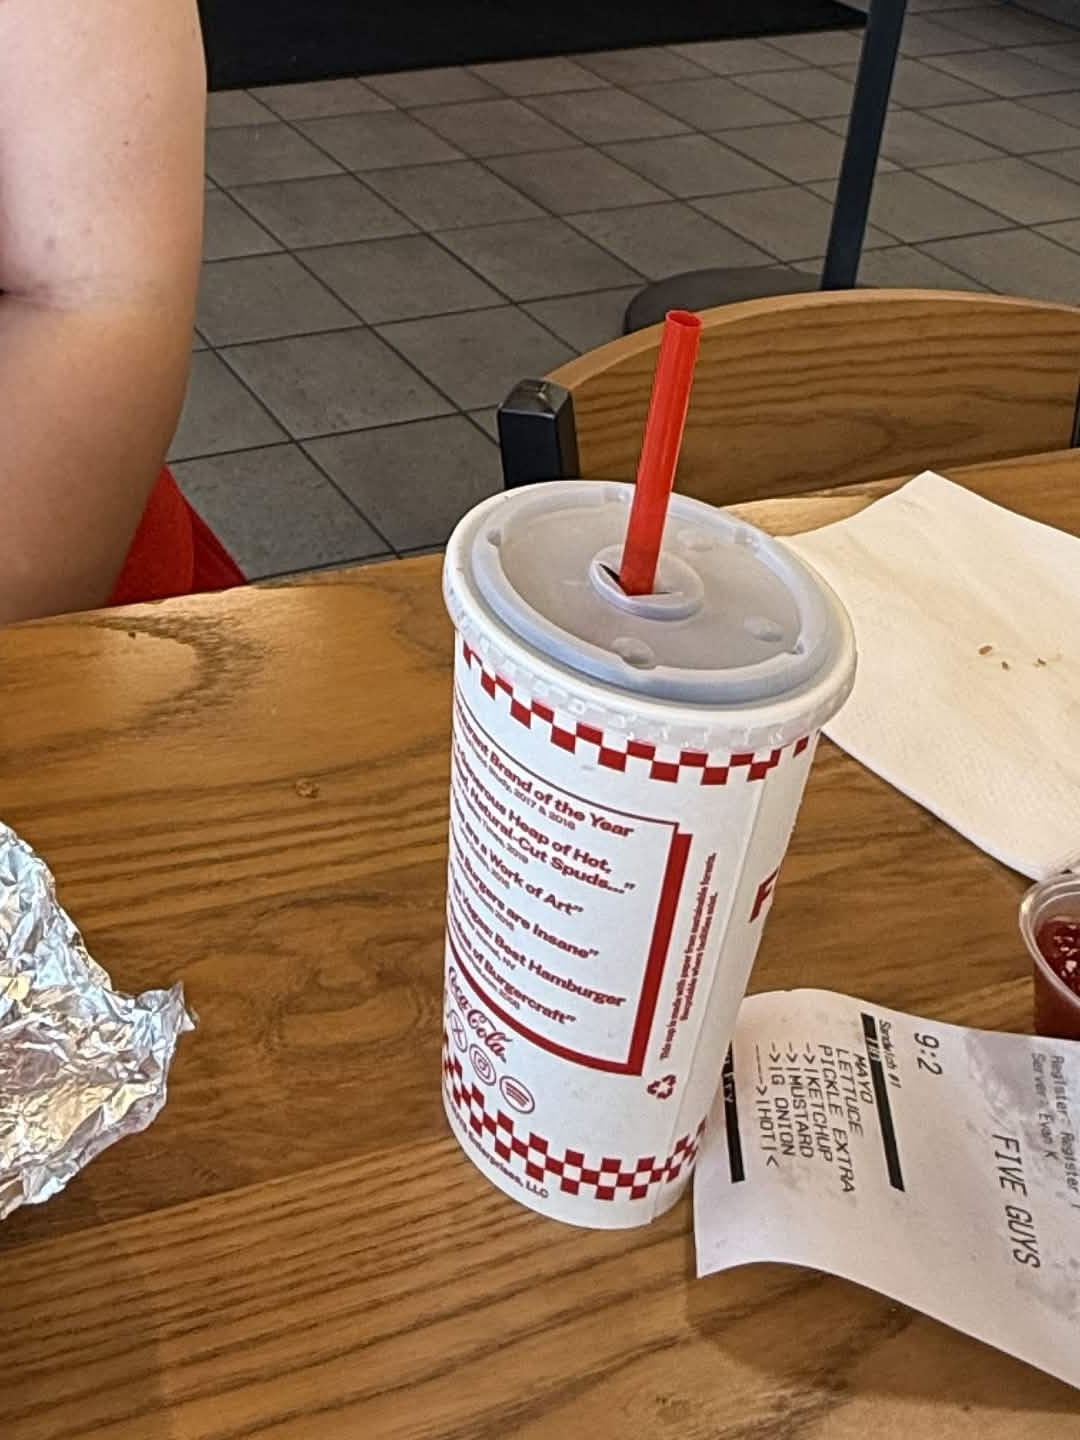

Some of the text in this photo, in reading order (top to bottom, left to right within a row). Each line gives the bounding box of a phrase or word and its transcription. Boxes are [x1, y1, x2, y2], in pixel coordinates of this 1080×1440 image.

[470, 786, 549, 864] Natural-Cut
[490, 750, 533, 794] Brand
[533, 789, 554, 806] of
[554, 797, 586, 822] the
[589, 812, 635, 839] Year
[489, 848, 525, 889] Work
[525, 882, 544, 899] of
[508, 809, 550, 846] Heap
[551, 840, 572, 857] of
[572, 848, 613, 874] Hot,
[463, 854, 506, 911] Burgers
[506, 907, 531, 930] are
[494, 932, 527, 967] Best
[528, 958, 627, 1008] Hamburger
[852, 1052, 875, 1105] MAYO
[914, 1031, 944, 1076] 9:2
[774, 1096, 797, 1157] ONION
[817, 1043, 856, 1193] PICKLE EXTRA
[835, 1047, 864, 1138] LETTUCE
[525, 1179, 550, 1200] LLC
[992, 1134, 1041, 1269] FIVE GUYS
